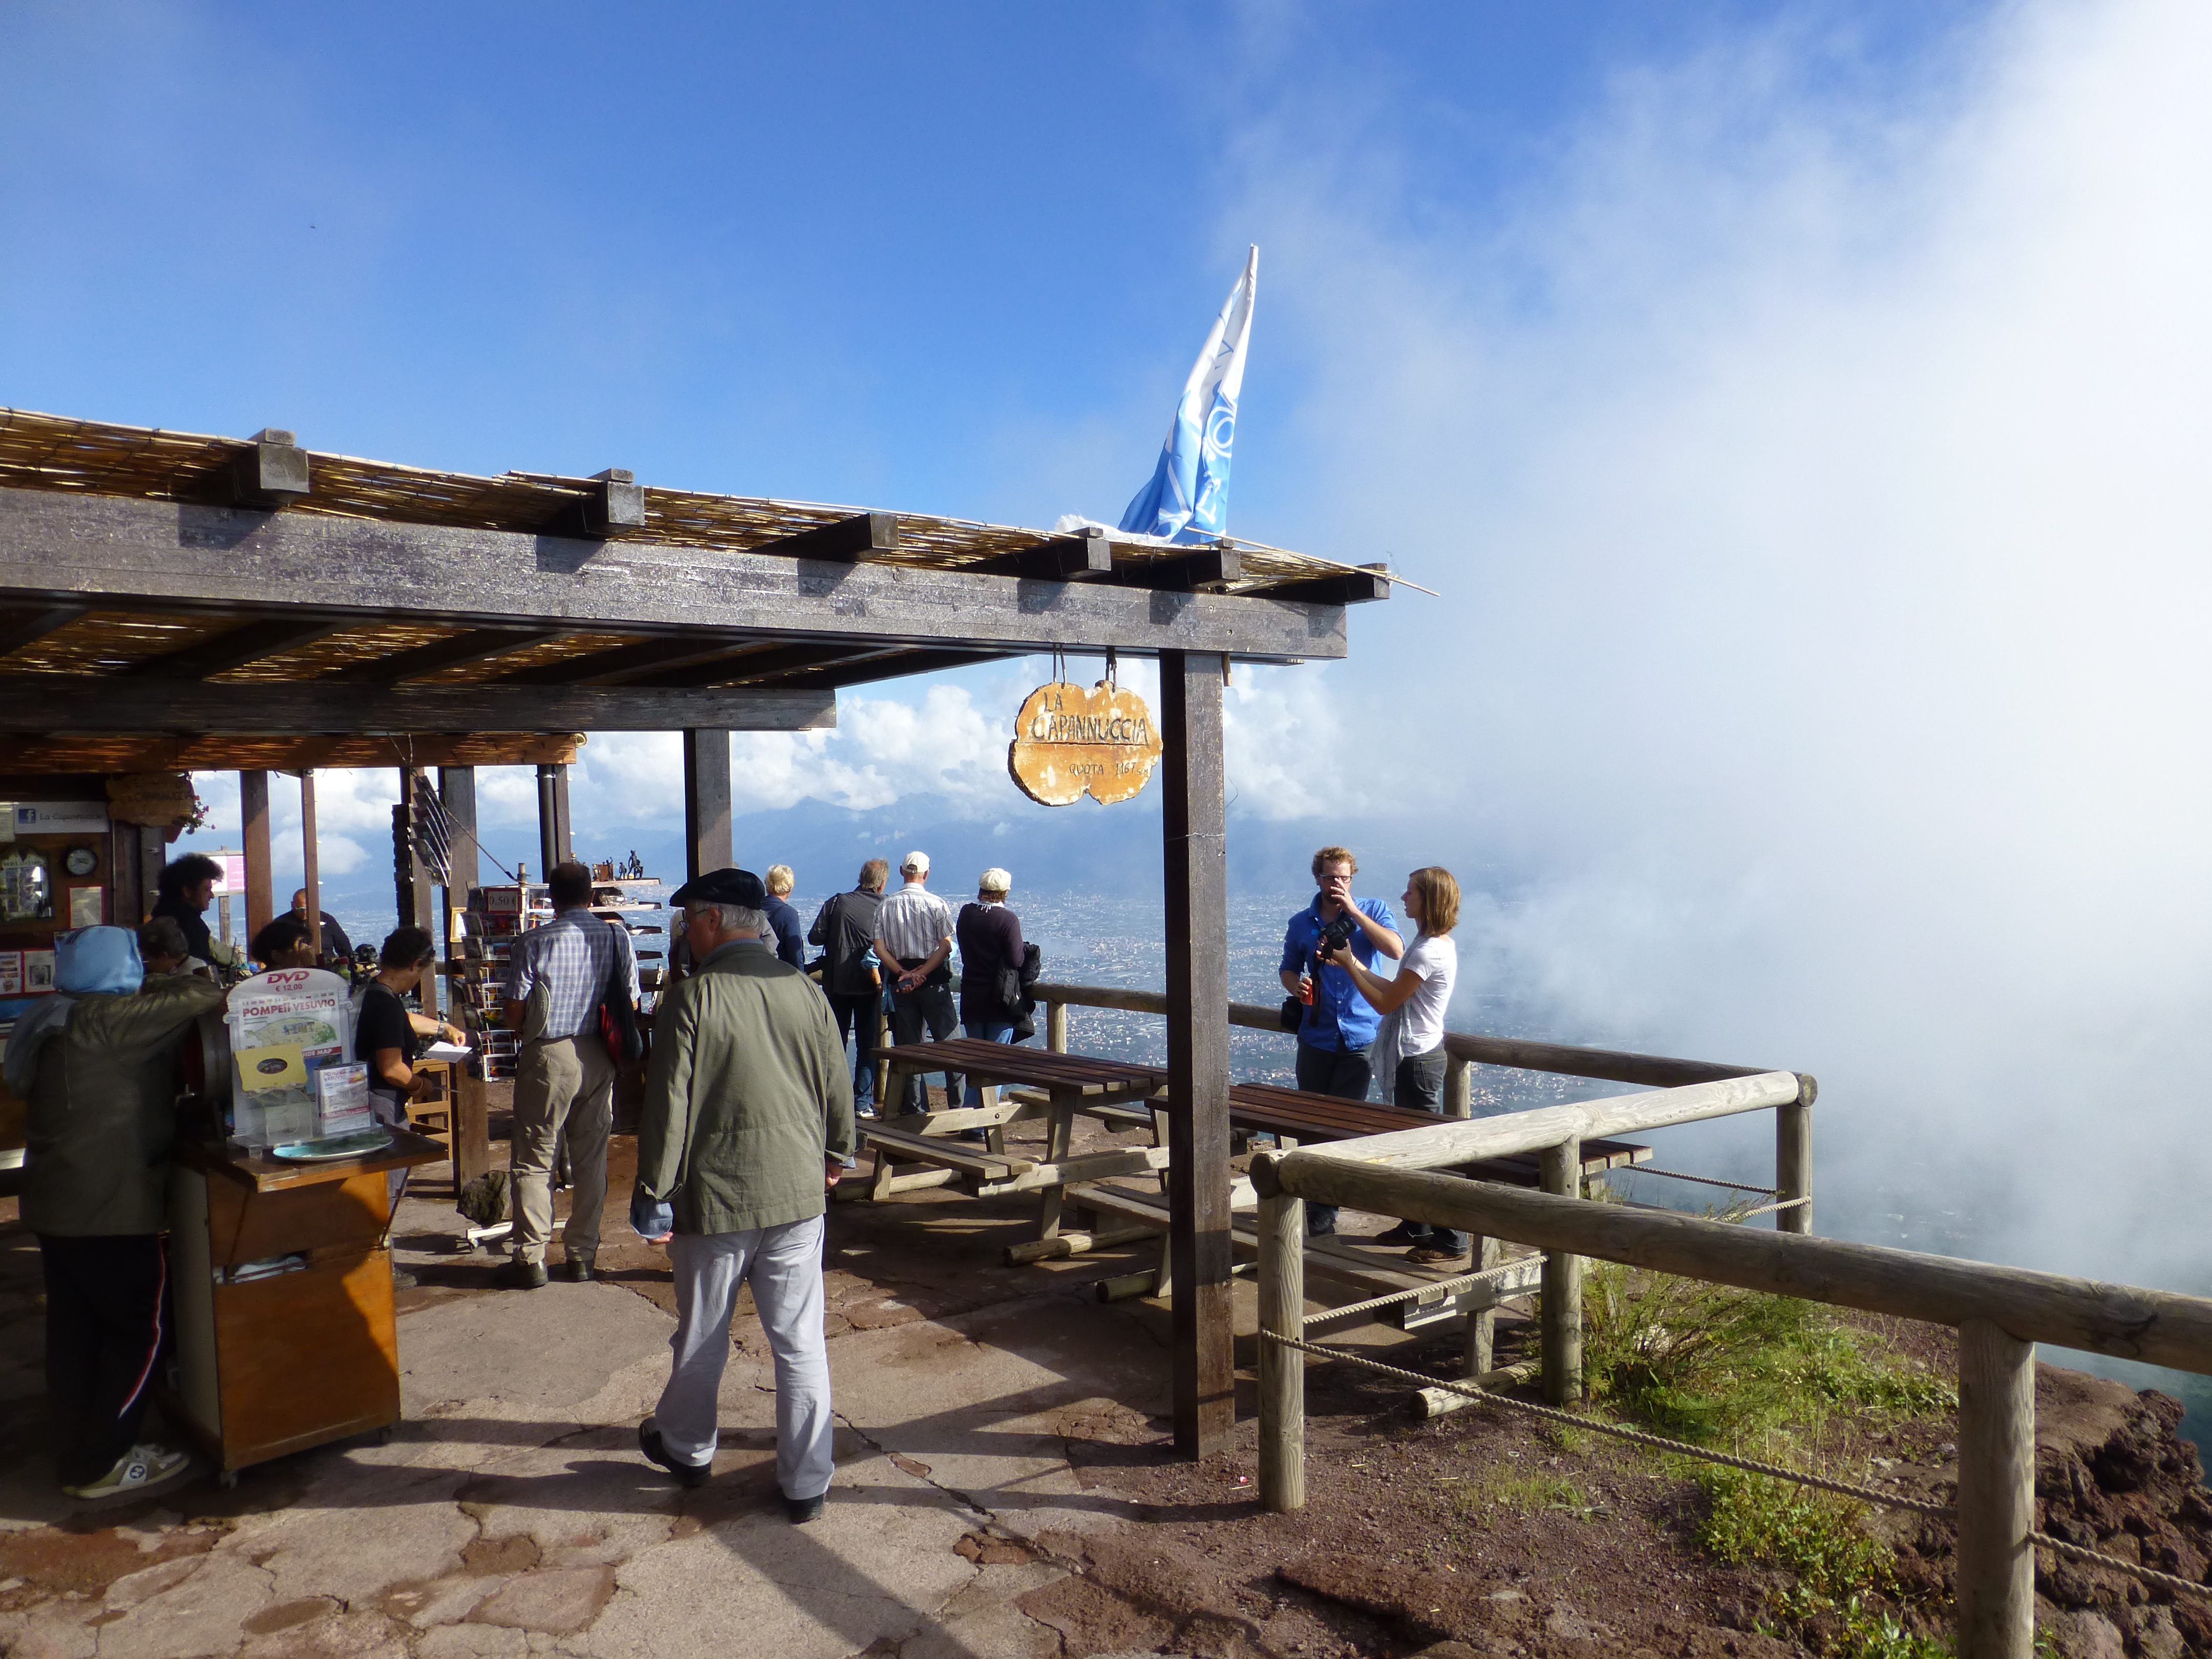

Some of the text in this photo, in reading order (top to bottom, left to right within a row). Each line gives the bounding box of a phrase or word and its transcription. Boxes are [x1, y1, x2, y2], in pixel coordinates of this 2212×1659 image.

[1044, 692, 1063, 712] LA
[1031, 715, 1150, 748] CAPANNUCCIA
[1069, 763, 1104, 776] QUOTA
[1115, 762, 1136, 775] 1167
[489, 896, 509, 906] 0,50
[267, 971, 310, 984] DVD
[283, 984, 303, 992] 12,00
[292, 999, 336, 1011] VESUVIO
